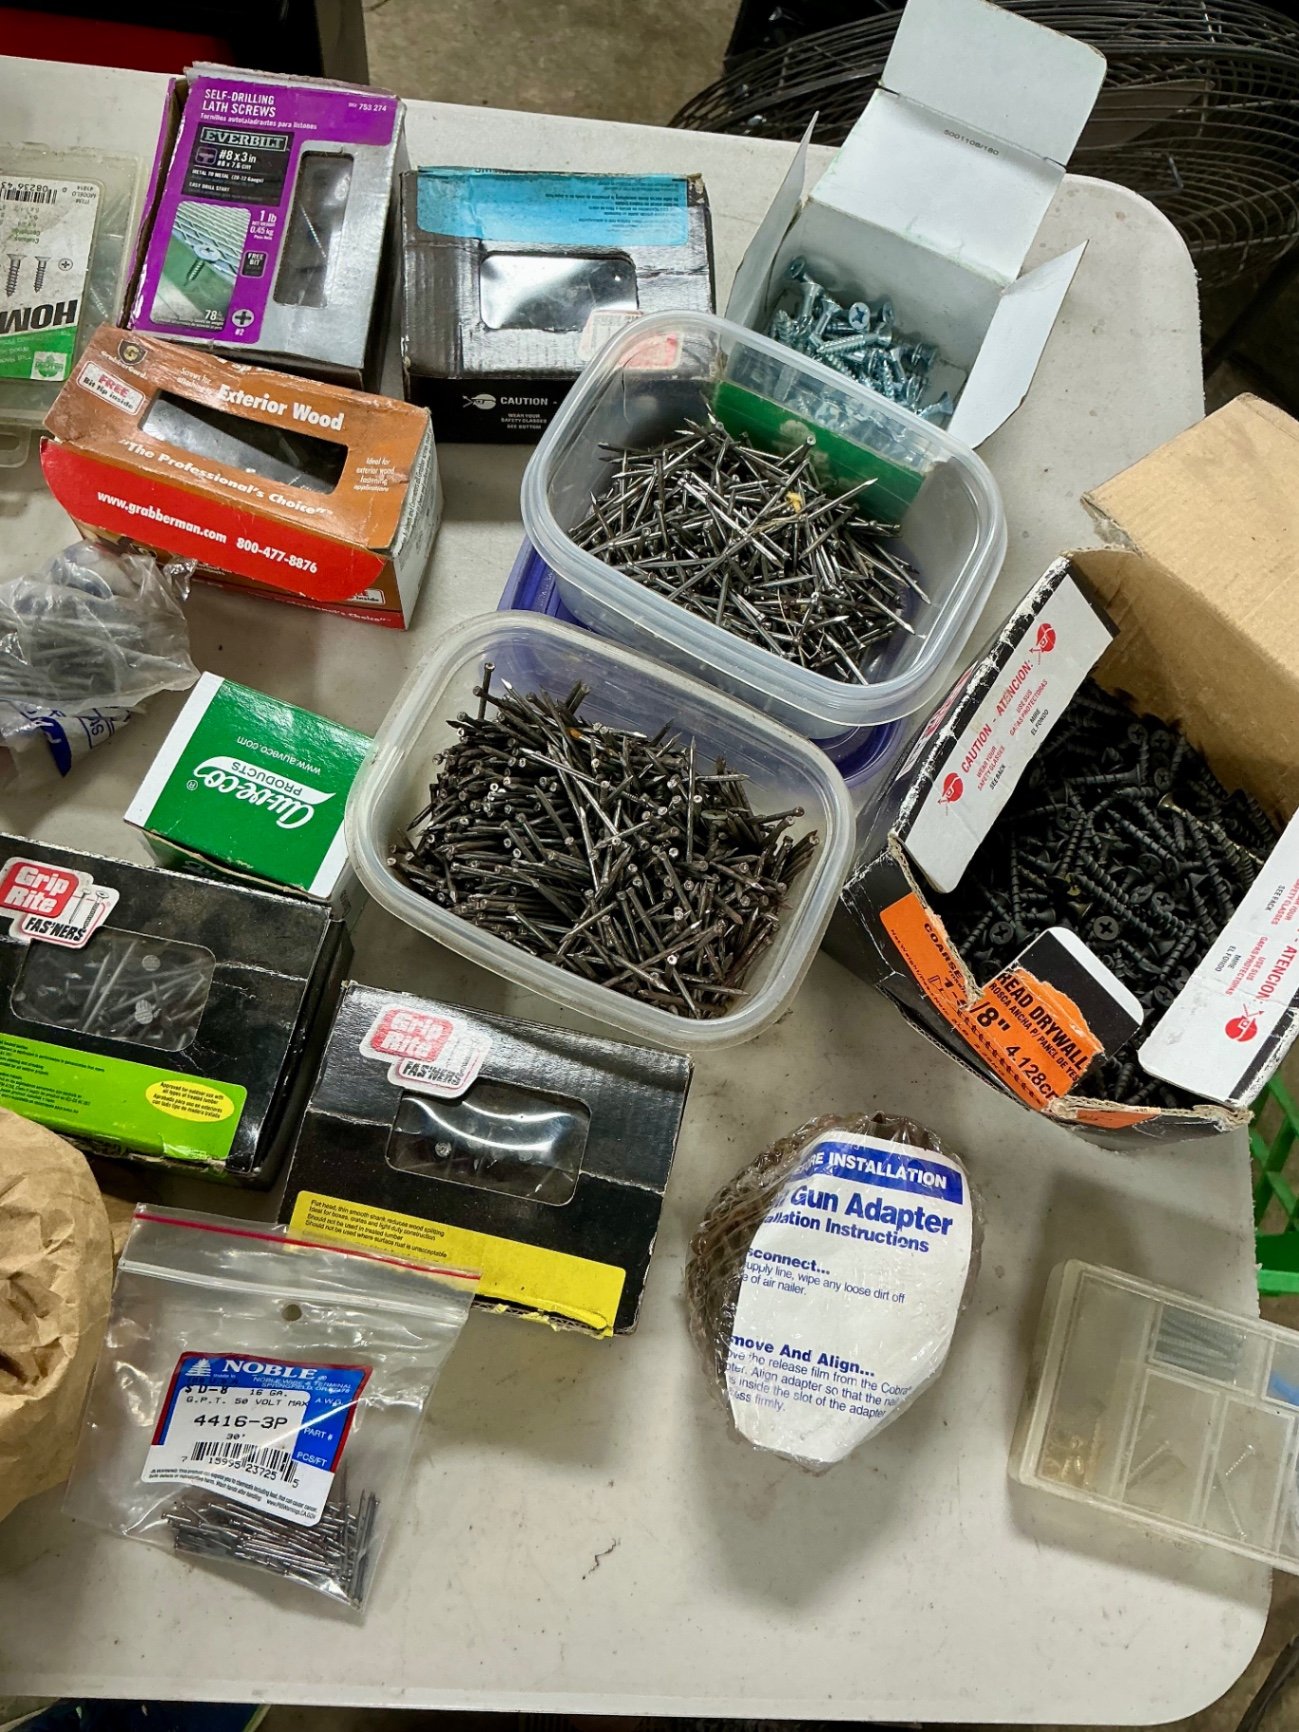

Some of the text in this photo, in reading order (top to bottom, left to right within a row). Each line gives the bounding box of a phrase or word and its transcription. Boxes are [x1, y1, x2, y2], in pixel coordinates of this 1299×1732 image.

[202, 100, 276, 118] LATH SCREWS
[204, 88, 275, 105] SELF-DRILLING
[358, 103, 372, 111] 753
[373, 104, 388, 112] 274
[204, 130, 284, 148] EVERBILT
[219, 150, 233, 160] #8
[242, 152, 248, 162] 3
[249, 154, 256, 164] in
[260, 210, 277, 222] 1 lb
[250, 226, 274, 237] 0.45 kg
[204, 310, 217, 321] 78
[82, 376, 96, 388] Bit
[98, 374, 130, 398] FREE
[218, 384, 288, 416] Exterior
[292, 402, 345, 432] Wood
[500, 396, 548, 406] CAUTION
[158, 452, 264, 498] Professional's
[96, 491, 318, 574] www.grabberman.com 800-477-8876
[960, 659, 1034, 774] CAUTION ATENCION:
[236, 736, 322, 776] www.auveco.com
[230, 760, 304, 796] PRODUCTS
[14, 866, 70, 895] Grip
[2, 886, 58, 912] Rite
[24, 917, 86, 942] FAS'NERS
[1254, 945, 1298, 1004] ATENCION:
[924, 922, 964, 980] COARSE
[1029, 1004, 1088, 1071] DRYWALL
[390, 1012, 444, 1040] Grip
[988, 982, 1010, 1008] ROSCA
[1008, 1006, 1033, 1030] ANCHA
[1036, 1033, 1058, 1059] PANEL
[1056, 1055, 1068, 1068] DE
[380, 1031, 432, 1057] Rite
[402, 1061, 462, 1086] FAS'NERS
[828, 1152, 947, 1189] INSTALLATION
[322, 1202, 336, 1212] head,
[349, 1208, 369, 1218] smooth
[370, 1214, 386, 1222] shank
[408, 1222, 424, 1231] wood
[790, 1184, 839, 1212] Gun
[844, 1192, 954, 1236] Adapter
[305, 1220, 324, 1229] Should
[342, 1229, 356, 1237] used
[357, 1232, 374, 1241] where
[374, 1236, 394, 1246] surface
[412, 1245, 447, 1258] unacceptable
[307, 1213, 326, 1223] Should
[344, 1221, 358, 1230] used
[365, 1227, 384, 1236] treated
[384, 1232, 403, 1241] lumber
[391, 1225, 403, 1234] duty
[404, 1228, 436, 1241] construction
[826, 1217, 930, 1253] Instructions
[750, 1274, 807, 1296] of air nailer.
[775, 1265, 794, 1280] line,
[798, 1272, 821, 1286] wipe
[823, 1279, 842, 1293] any
[844, 1281, 871, 1297] loose
[874, 1288, 890, 1300] dirt
[892, 1293, 906, 1304] off
[222, 1360, 318, 1380] NOBLE
[779, 1344, 812, 1363] And
[817, 1352, 875, 1377] Align...
[751, 1367, 882, 1405] Align adapter so that the
[768, 1359, 807, 1375] release
[811, 1367, 830, 1381] film
[832, 1371, 858, 1386] from
[860, 1378, 878, 1391] the
[186, 1396, 226, 1405] G.P.T.
[234, 1397, 248, 1405] 50
[255, 1398, 282, 1406] VOLT
[269, 1389, 288, 1397] GA.
[739, 1376, 886, 1419] inside the slot of the adapter
[754, 1394, 786, 1413] firmly.
[194, 1414, 326, 1438] 4416-3P PART
[208, 1457, 241, 1470] 15995
[245, 1464, 277, 1480] 23725
[292, 1479, 300, 1488] 5
[296, 1451, 328, 1467] PCS/FT
